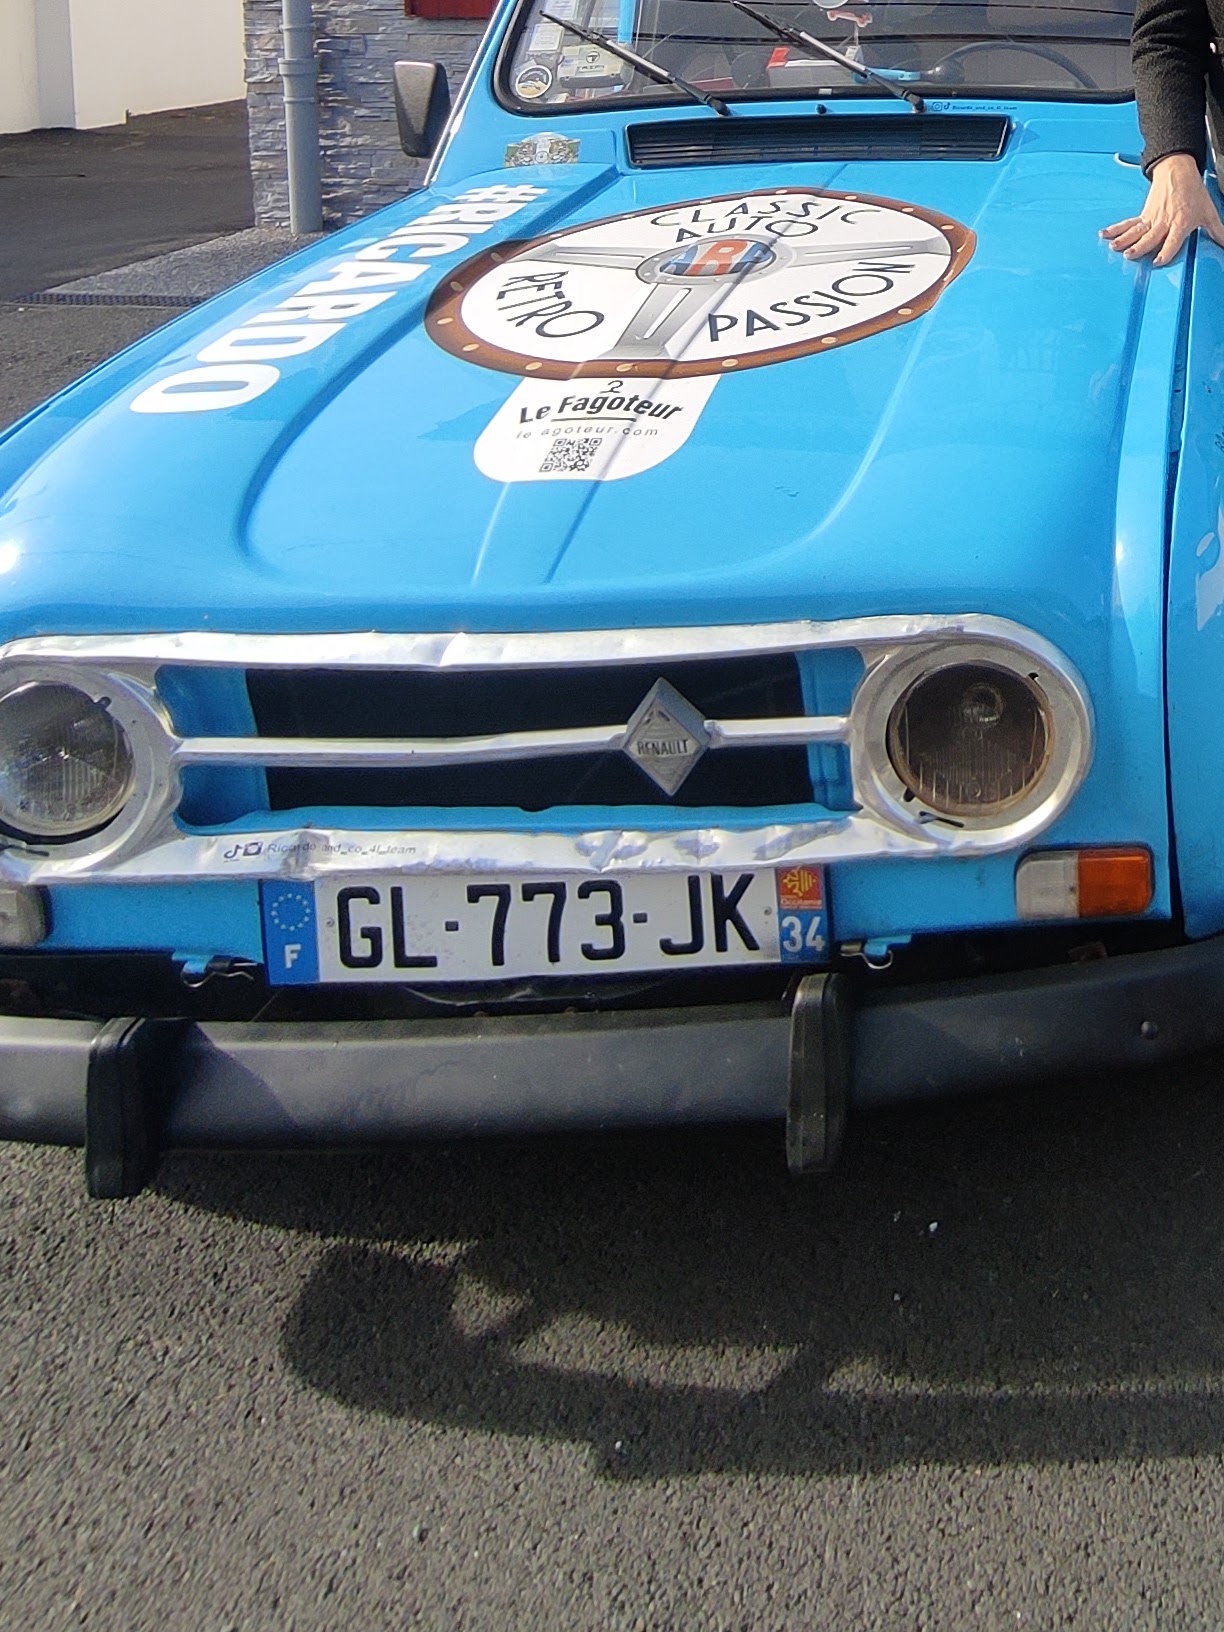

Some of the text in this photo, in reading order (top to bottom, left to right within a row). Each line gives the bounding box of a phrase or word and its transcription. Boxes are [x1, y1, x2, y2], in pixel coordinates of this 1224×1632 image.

[649, 200, 882, 226] CLASSIC
[676, 215, 819, 243] AUTO
[129, 183, 549, 415] #RICARDO
[496, 270, 605, 338] RETRO
[707, 261, 916, 342] PASSION
[519, 394, 686, 424] Le Fagoteur
[636, 738, 689, 755] RENAULT
[336, 872, 761, 969] GL-773-JK
[781, 915, 826, 953] 34
[284, 943, 302, 969] F
